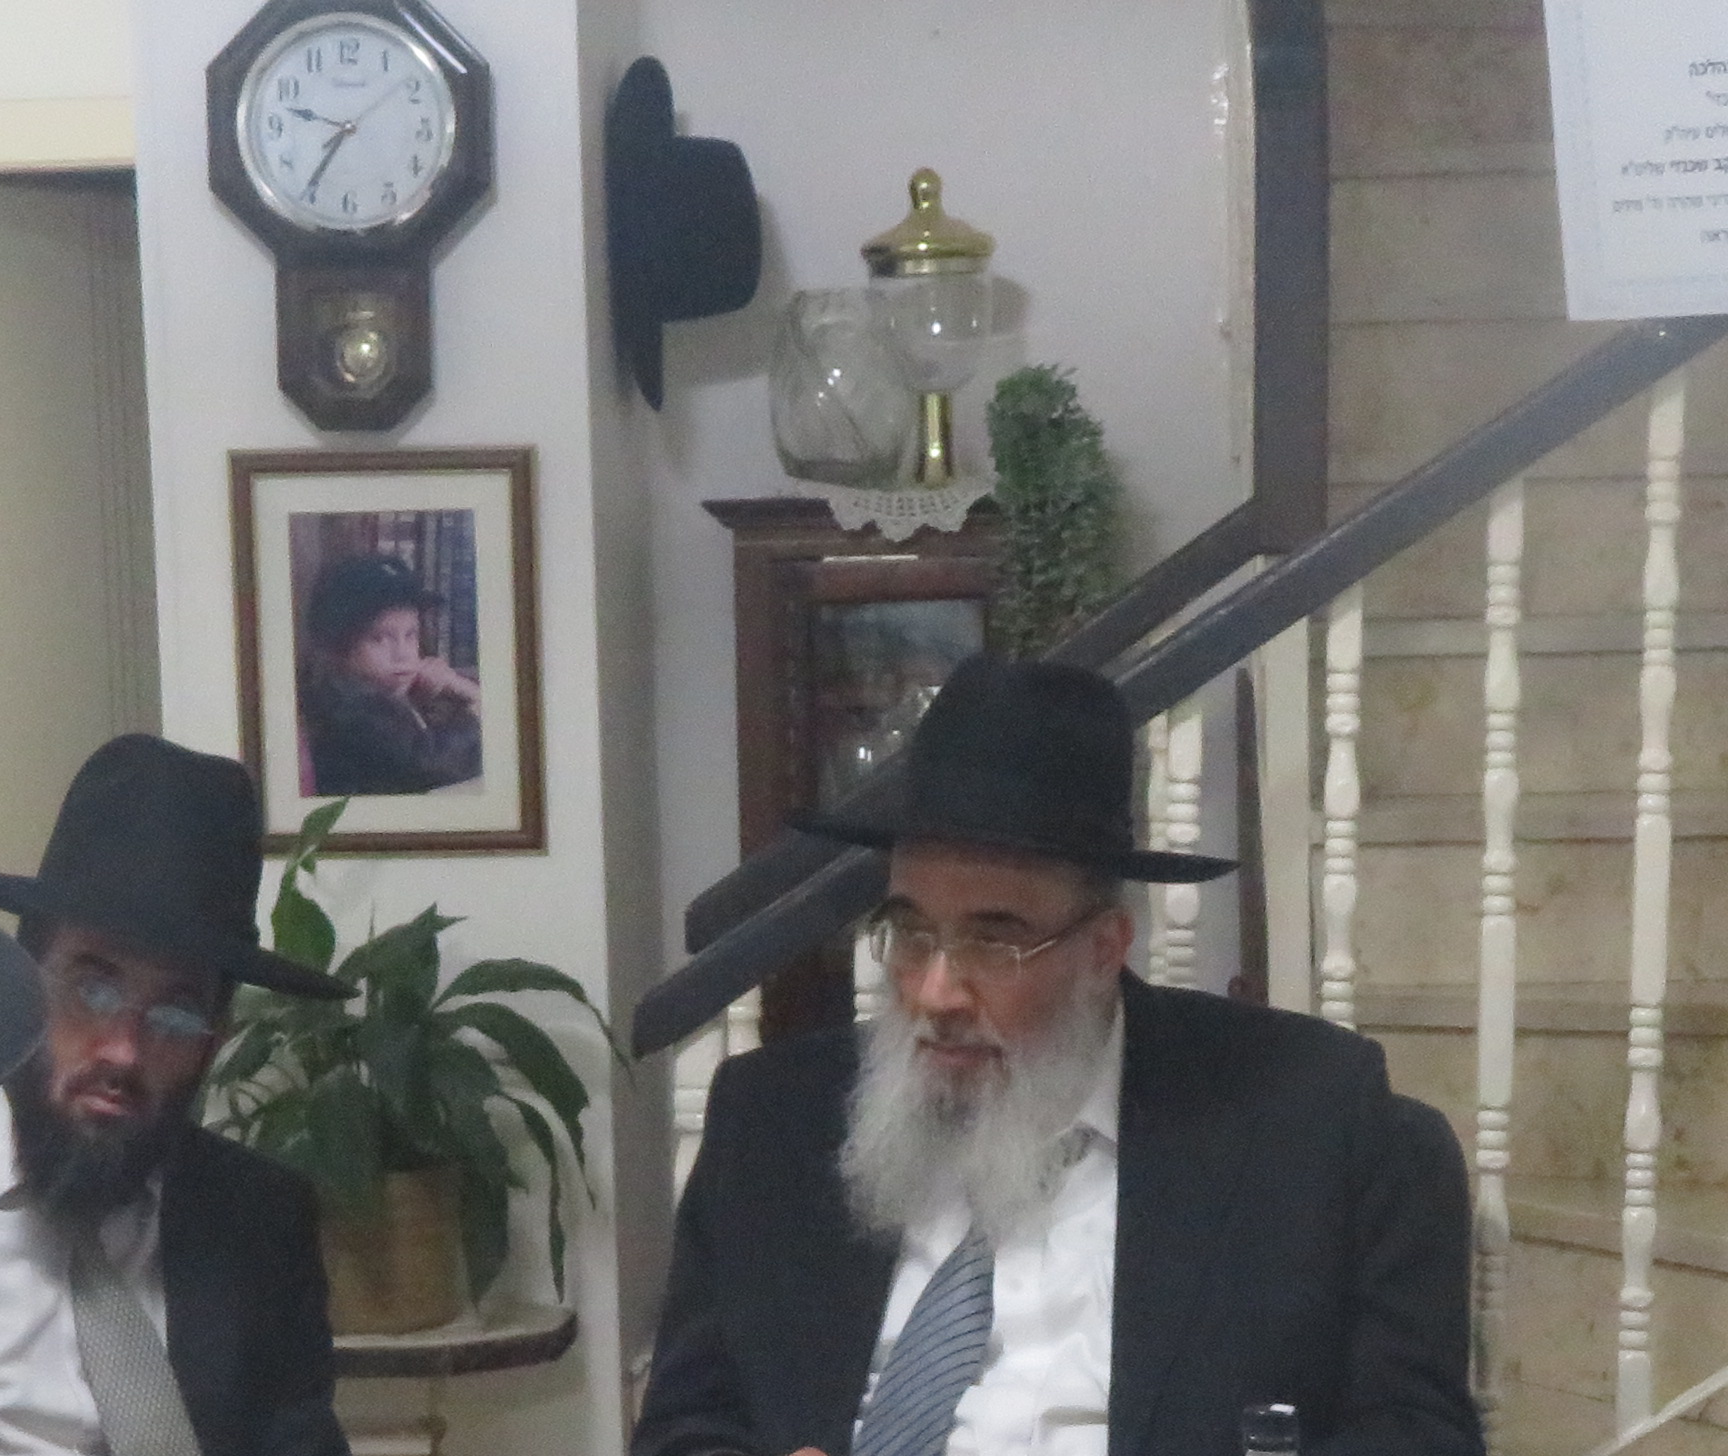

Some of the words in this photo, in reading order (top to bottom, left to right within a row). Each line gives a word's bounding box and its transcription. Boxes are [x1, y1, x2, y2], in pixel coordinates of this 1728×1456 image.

[307, 47, 322, 73] 11
[340, 39, 360, 65] 12
[382, 49, 389, 72] 1
[278, 77, 299, 101] 10
[406, 80, 420, 104] 2
[268, 113, 283, 139] 9
[411, 154, 423, 177] 4
[342, 191, 358, 214] 6
[381, 182, 397, 206] 5
